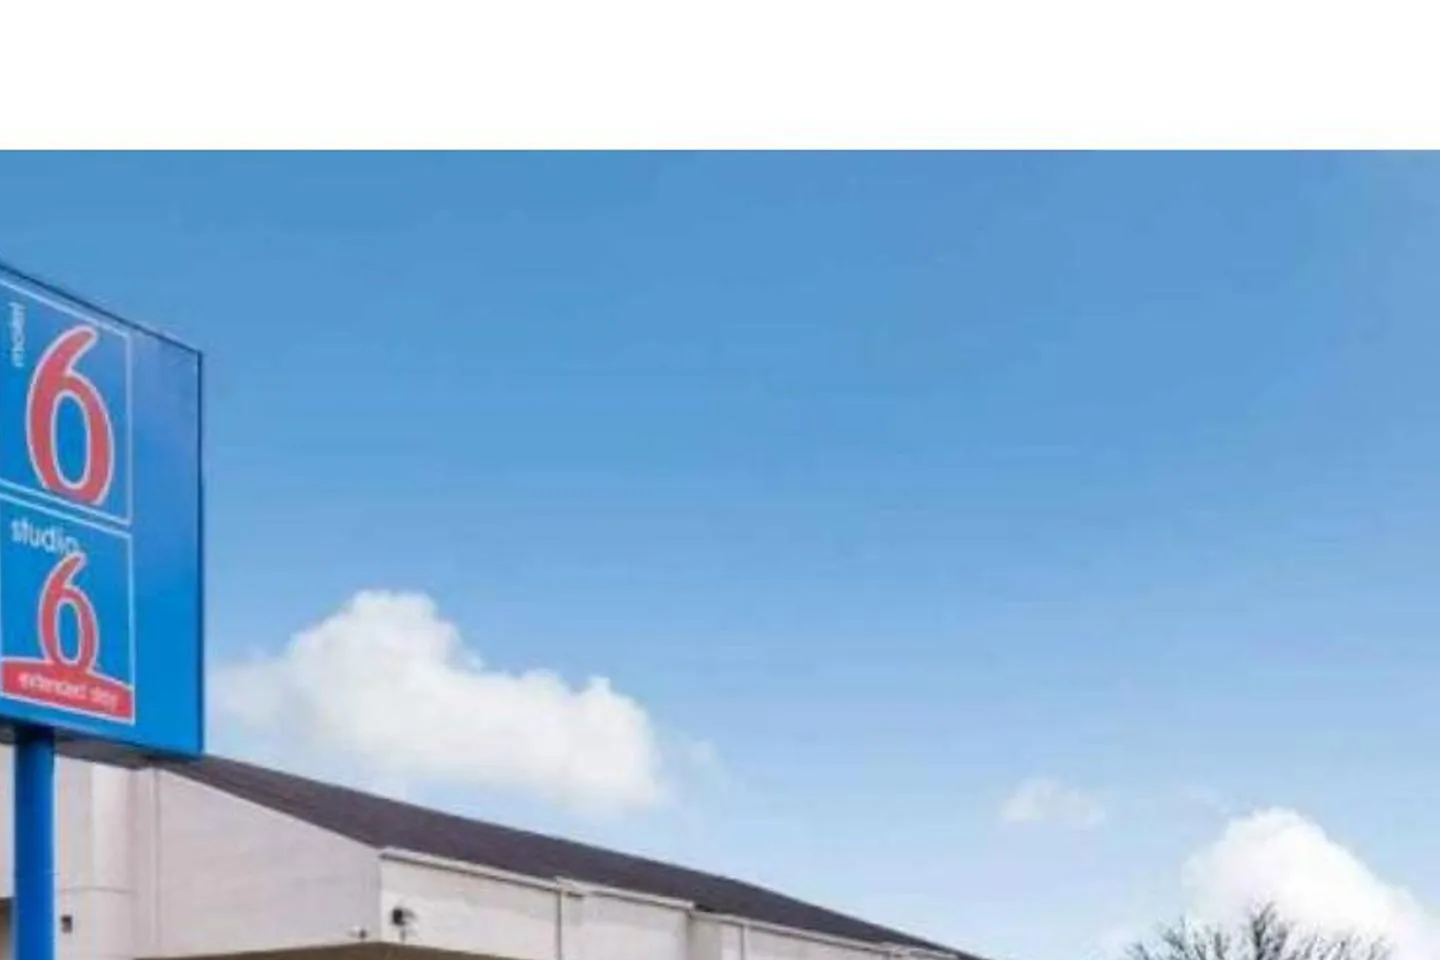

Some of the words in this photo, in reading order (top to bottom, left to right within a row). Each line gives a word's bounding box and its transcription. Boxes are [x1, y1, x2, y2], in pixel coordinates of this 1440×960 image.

[26, 324, 115, 506] 6
[11, 517, 81, 557] studio
[40, 551, 99, 673] 6
